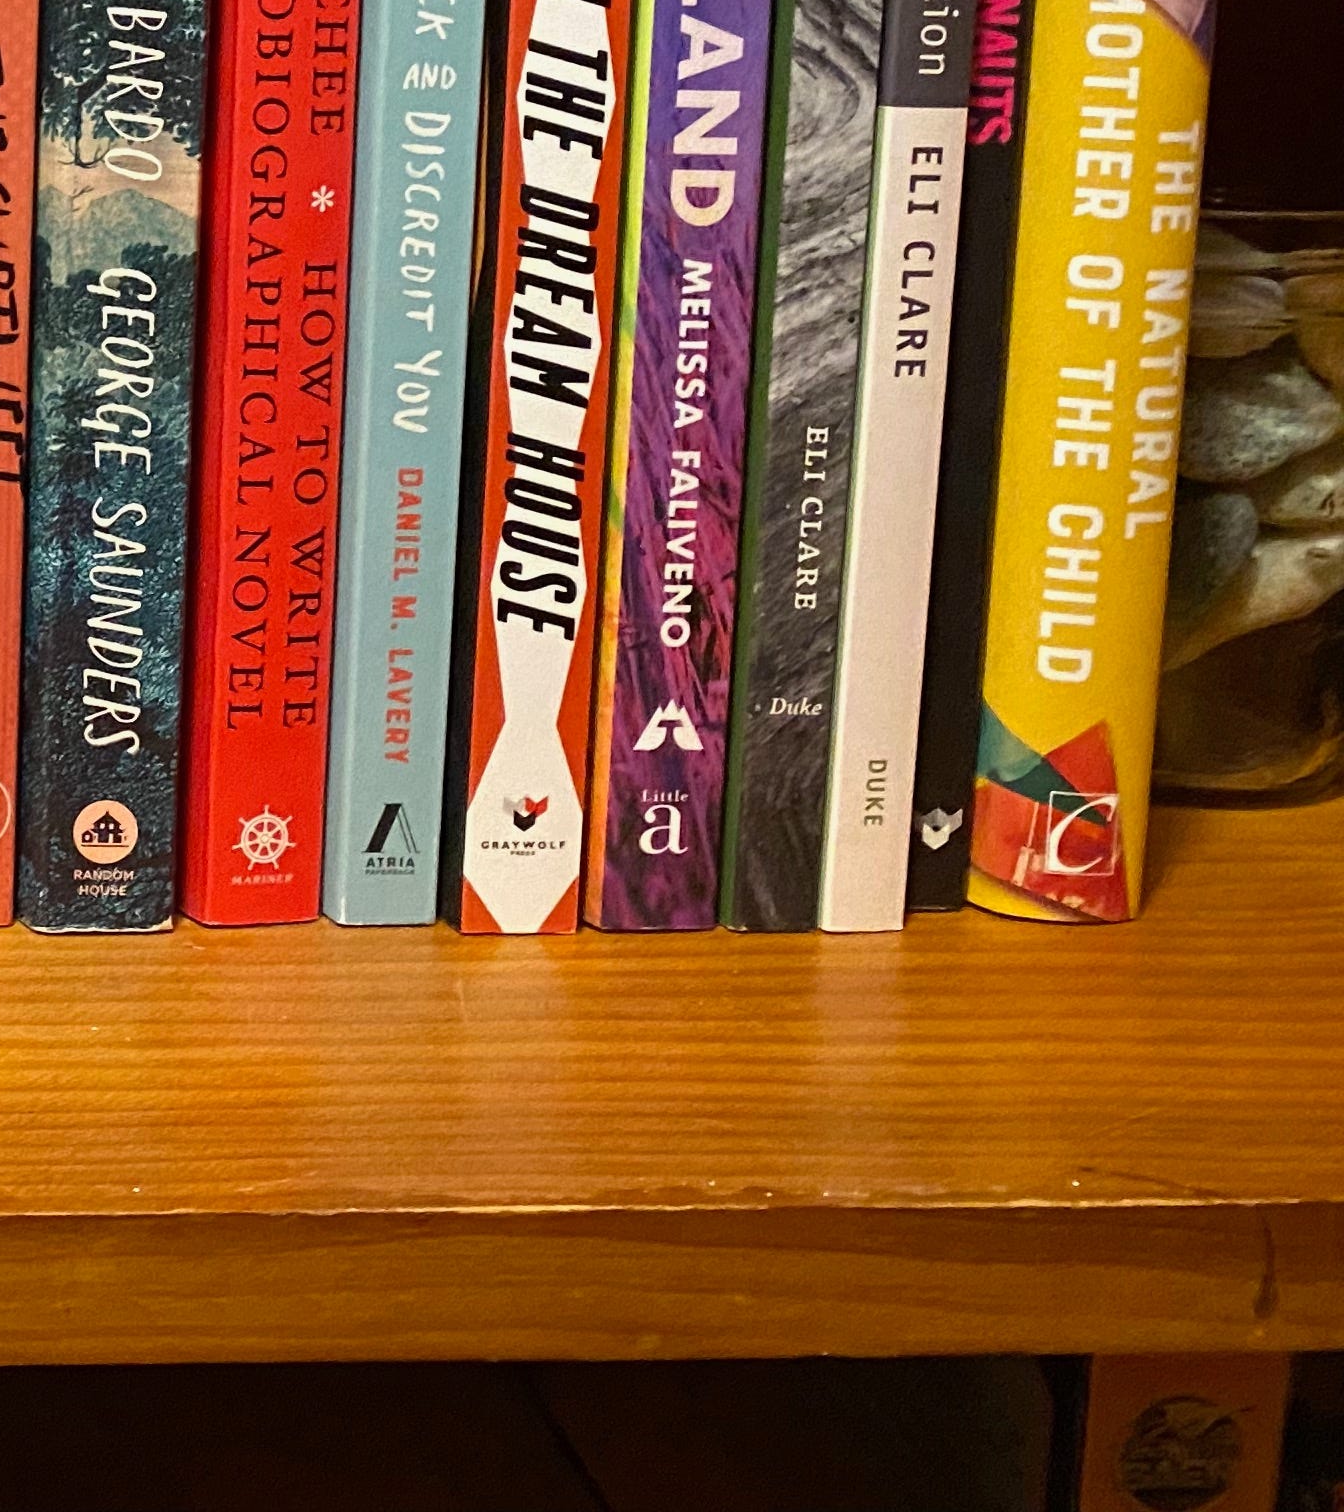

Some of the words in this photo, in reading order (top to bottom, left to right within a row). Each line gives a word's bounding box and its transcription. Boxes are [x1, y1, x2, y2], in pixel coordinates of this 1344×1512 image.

[104, 4, 168, 183] BARDO
[402, 62, 457, 90] AND
[522, 39, 609, 161] THE
[397, 110, 452, 333] DISCREDIT
[907, 145, 944, 216] ELI
[1150, 120, 1201, 235] THE
[296, 261, 339, 410] HOW
[509, 183, 599, 410] DREAM
[674, 258, 713, 429] MELISSA
[894, 239, 938, 379] CLARE
[1064, 254, 1124, 330] OF
[85, 266, 158, 476] GEORGE
[393, 349, 441, 434] YOU
[1052, 359, 1116, 472] THE
[1123, 268, 1190, 541] NATURAL
[293, 425, 331, 507] TO
[801, 425, 830, 483] ELI
[395, 467, 424, 582] DANIEL
[497, 432, 586, 643] HOUSE
[660, 449, 702, 648] FALIVENO
[794, 495, 824, 611] CLARE
[83, 496, 147, 756] SAUNDERS
[226, 528, 272, 731] NOVEL
[282, 528, 327, 729] WRITE
[1037, 504, 1108, 685] CHILD
[384, 648, 414, 765] LAVERY
[769, 697, 823, 717] Duke
[481, 840, 567, 851] GRAYWOLF
[641, 789, 689, 803] Little
[862, 759, 888, 828] DUKE
[73, 869, 135, 882] RANDOM
[78, 884, 128, 897] HOUSE
[365, 857, 416, 868] ATRIA
